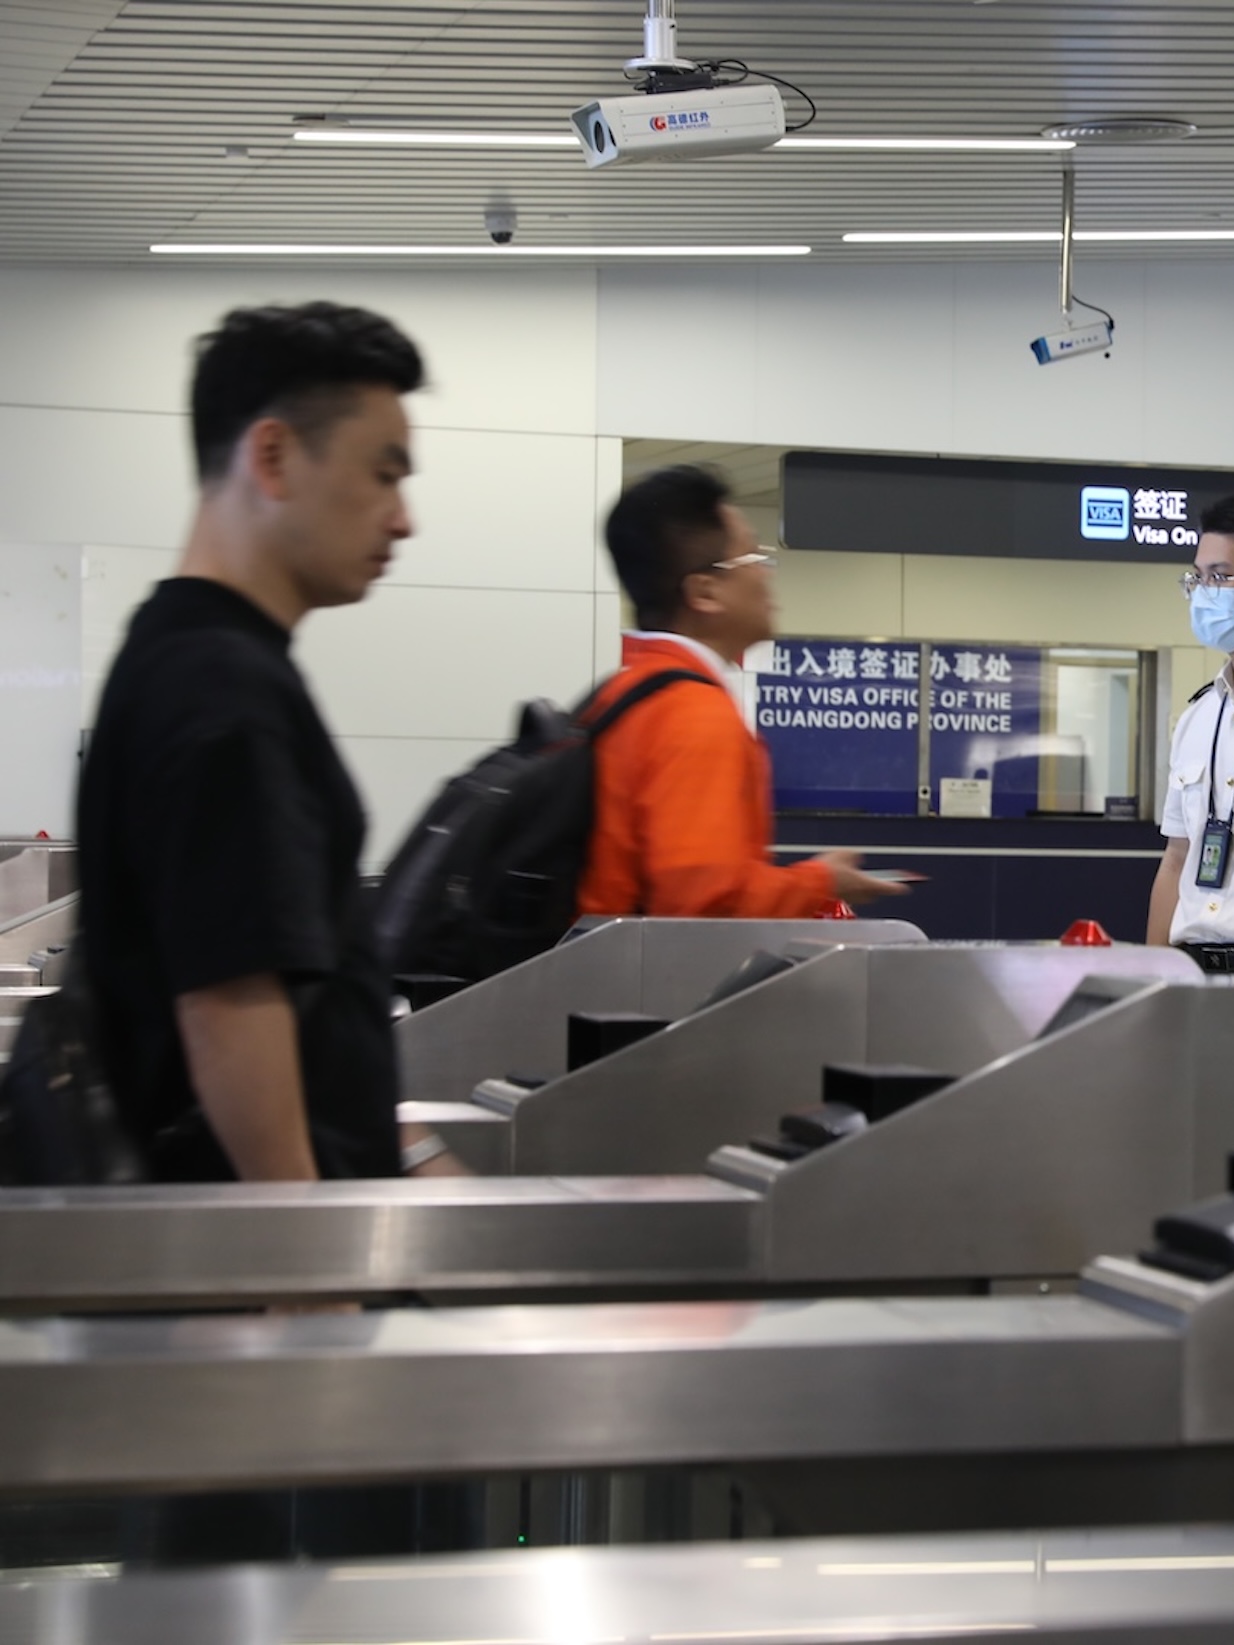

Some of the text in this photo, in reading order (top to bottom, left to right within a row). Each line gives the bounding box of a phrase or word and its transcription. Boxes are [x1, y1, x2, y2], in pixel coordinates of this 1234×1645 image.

[1088, 507, 1121, 519] VISA
[1134, 489, 1187, 520] 签证
[1133, 525, 1199, 545] Visa On
[757, 685, 803, 705] TRY
[807, 687, 859, 706] VISA
[941, 690, 969, 708] OF
[973, 691, 1012, 710] THE
[759, 708, 1012, 733] GUANGDONG POVINCE
